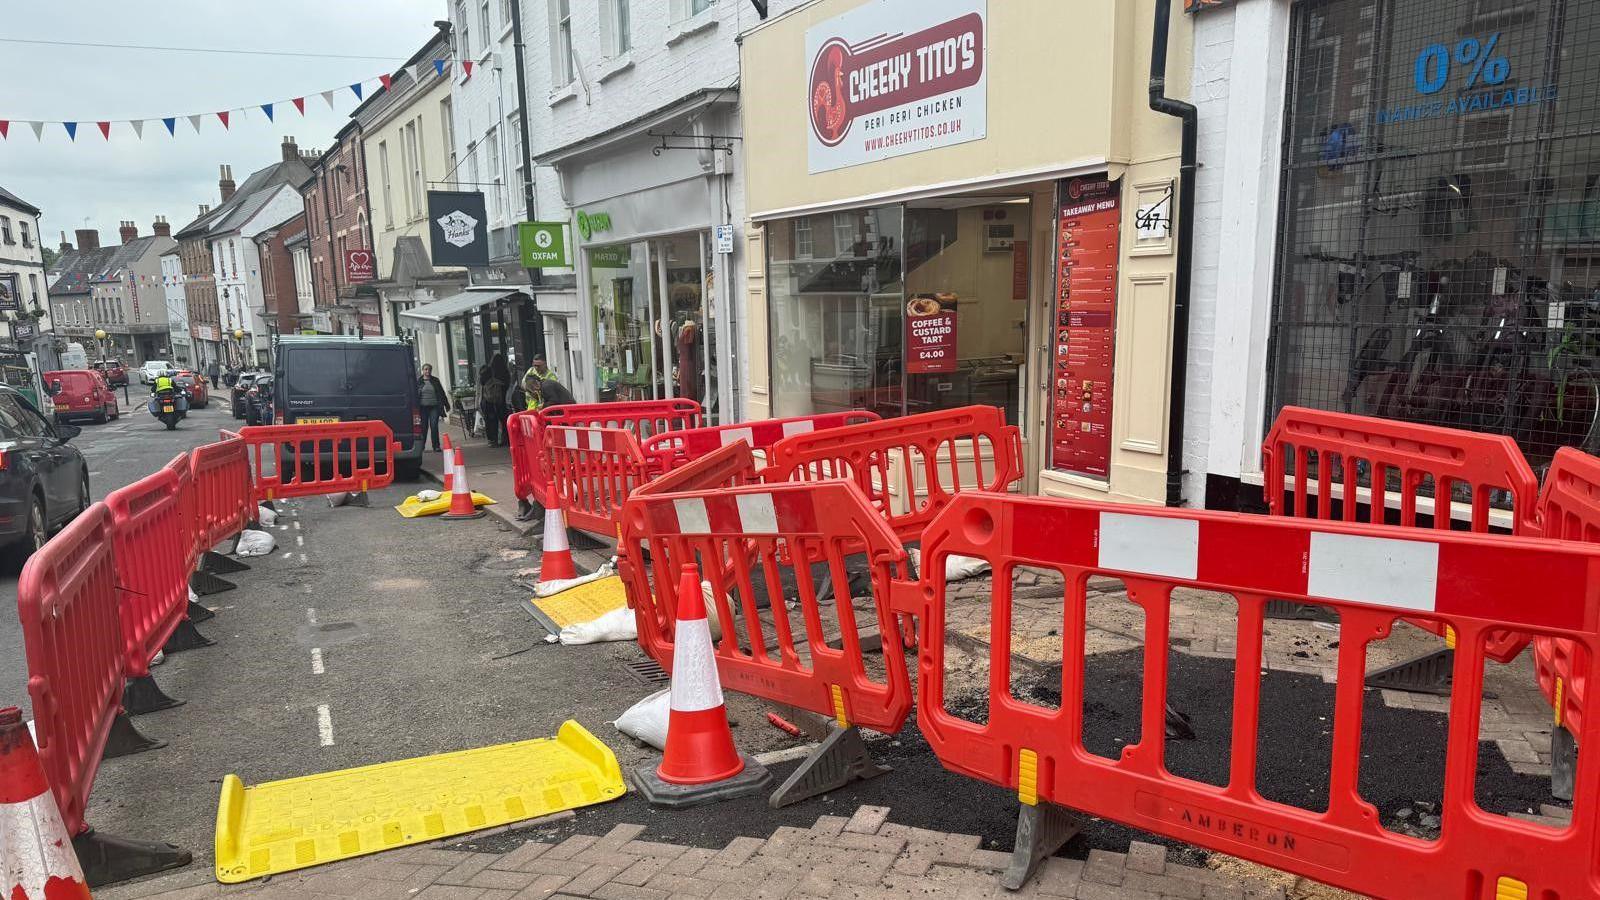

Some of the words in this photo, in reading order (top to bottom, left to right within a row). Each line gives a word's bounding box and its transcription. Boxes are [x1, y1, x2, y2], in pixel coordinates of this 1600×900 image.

[917, 32, 975, 83] TITO'S
[1414, 32, 1511, 94] 0%
[865, 116, 884, 131] PERI
[890, 109, 911, 125] PERI
[917, 96, 962, 118] CHICKEN
[1063, 203, 1095, 217] TAKEAWAY
[1097, 200, 1115, 211] MENU
[1142, 213, 1160, 230] 47
[532, 252, 558, 260] OXFAM
[912, 318, 943, 328] COFFEE
[945, 317, 951, 326] &
[913, 327, 951, 337] CUSTARD
[921, 336, 943, 344] TART
[920, 350, 944, 359] £4.00
[1182, 809, 1296, 850] AMBERON
